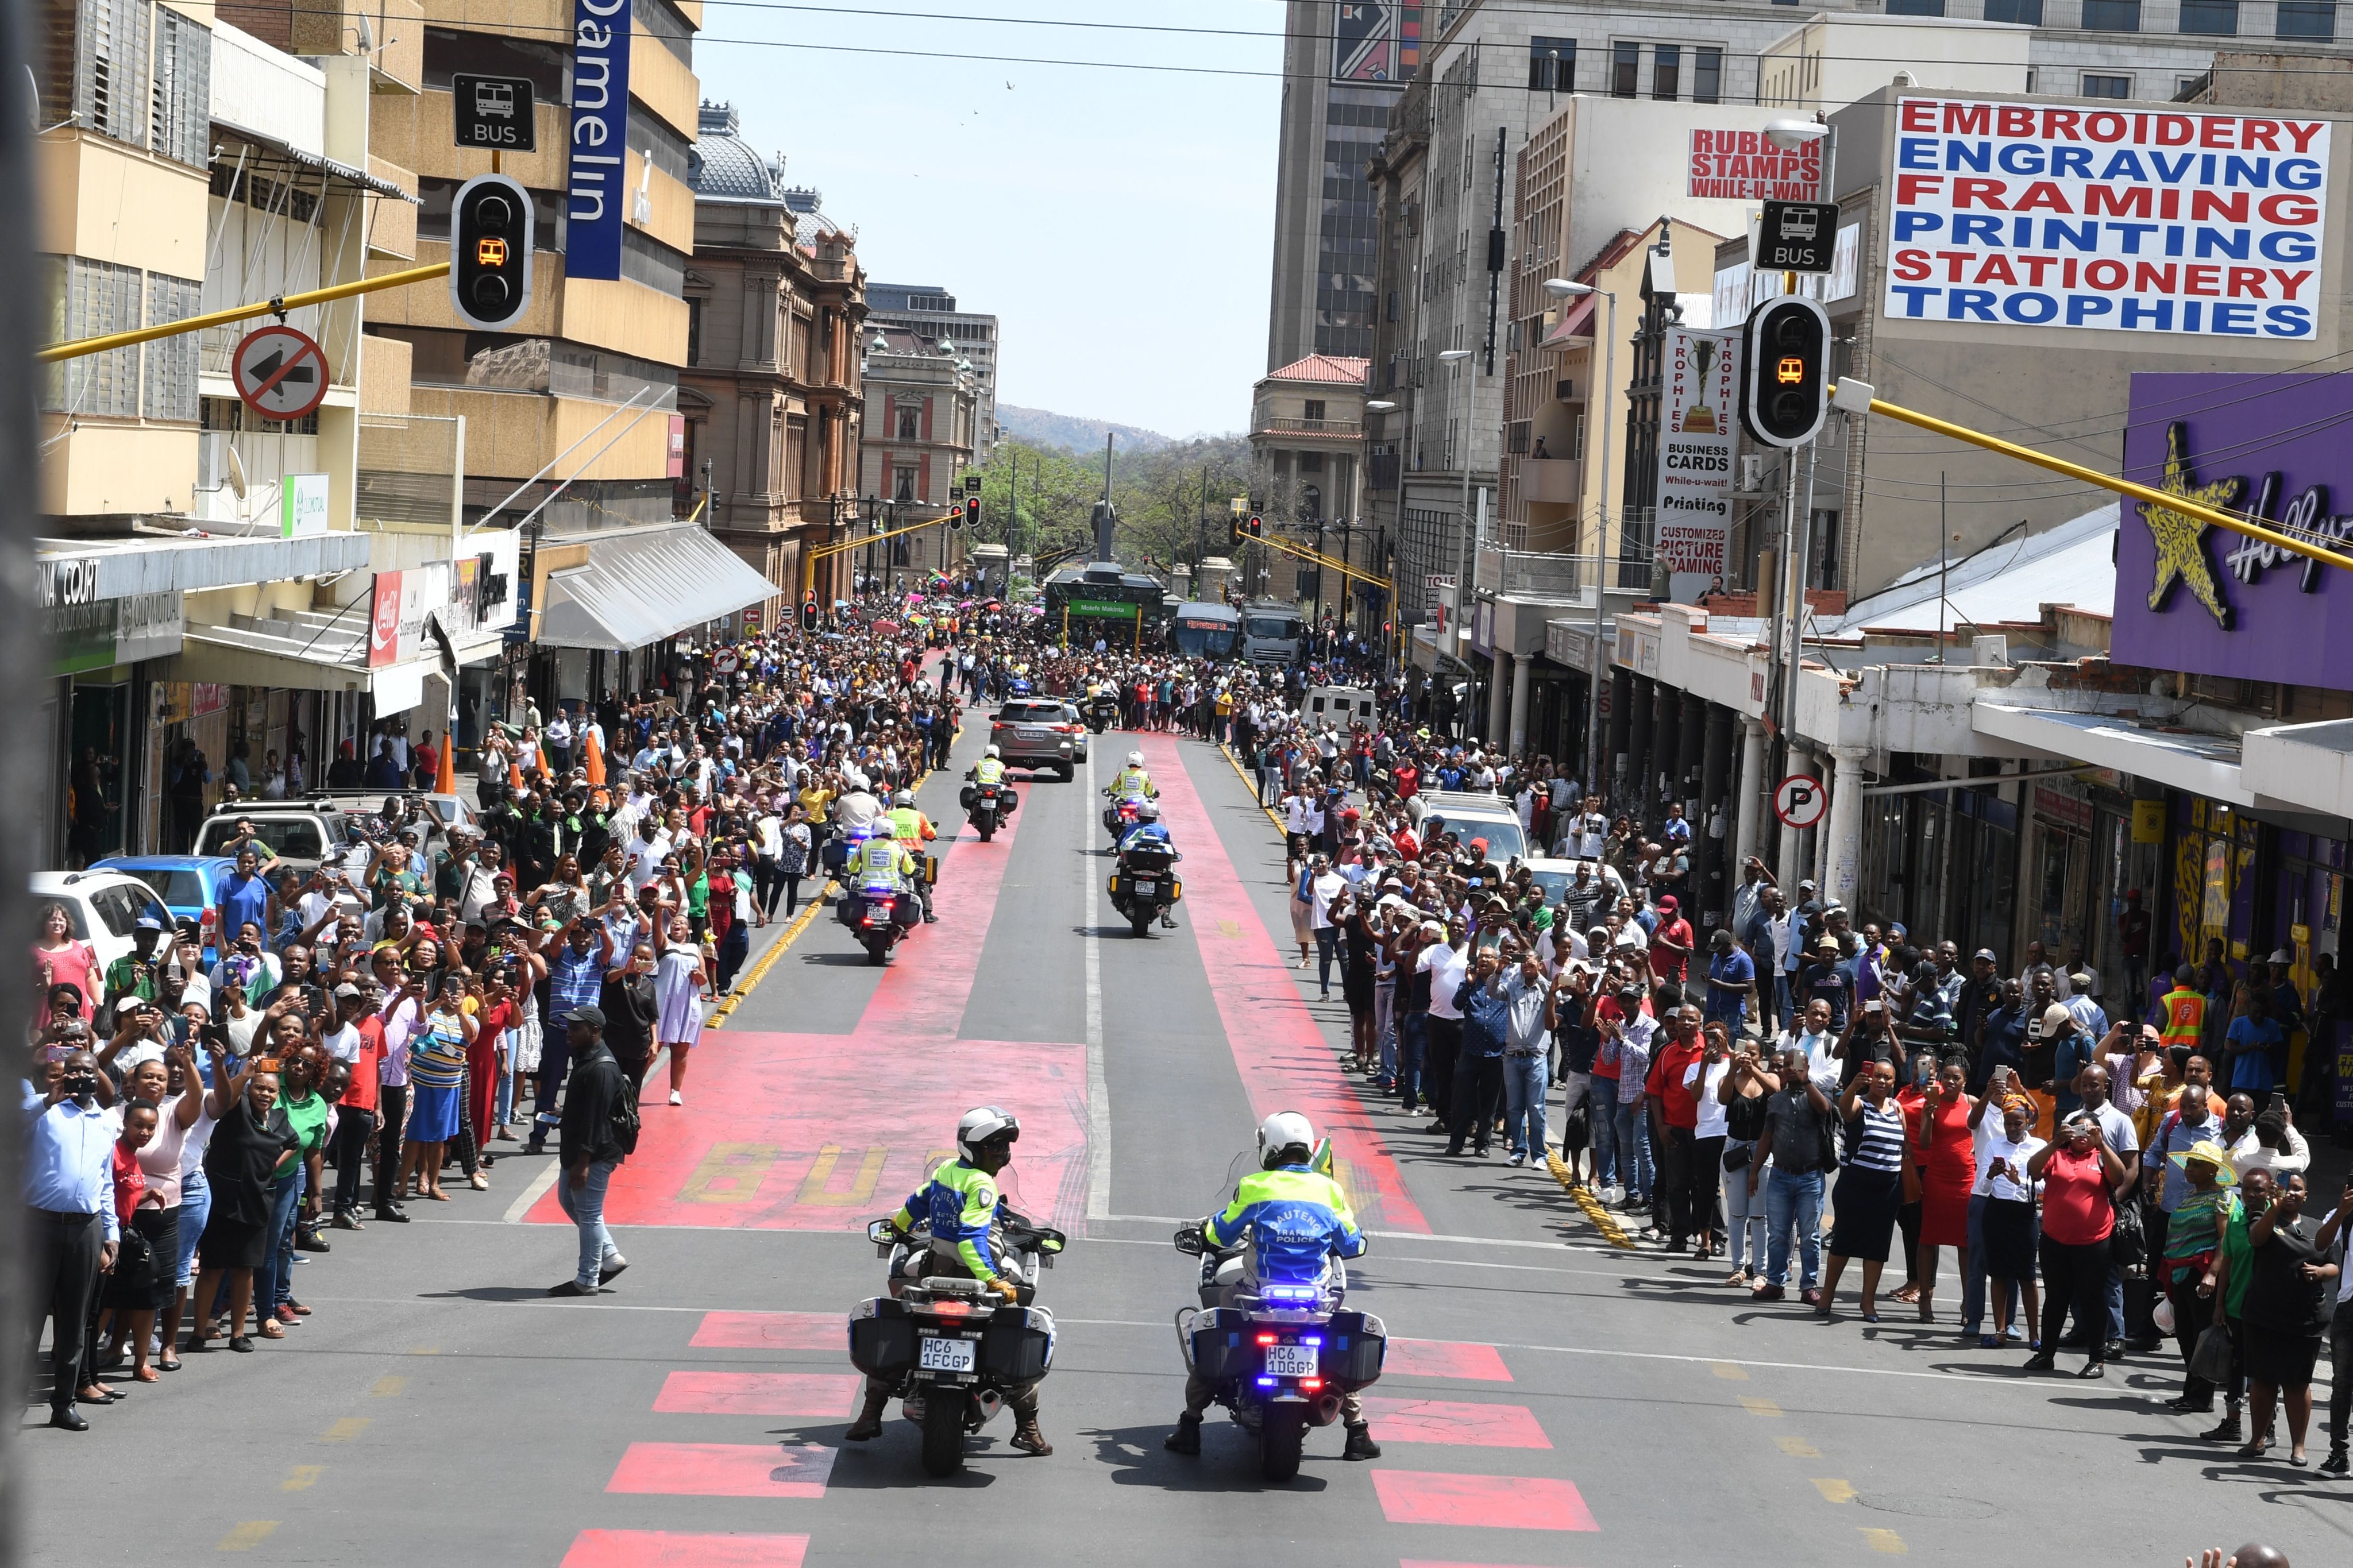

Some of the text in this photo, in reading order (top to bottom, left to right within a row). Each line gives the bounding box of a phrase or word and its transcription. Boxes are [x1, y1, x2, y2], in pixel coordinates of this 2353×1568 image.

[474, 124, 516, 144] BUS
[1902, 100, 2324, 154] EMBROIDERY
[1694, 129, 1820, 158] RUBBR
[1692, 153, 1820, 181] STAMPS
[1899, 137, 2322, 191] ENGRAVING
[1691, 178, 1819, 202] WHILE-U-WAIT
[1897, 173, 2319, 226] FRAMING
[1894, 210, 2316, 263] PRINTING
[1774, 247, 1815, 265] BUS
[1893, 249, 2313, 300] STATIONERY
[1891, 285, 2312, 337] TROPHIES
[1671, 335, 1687, 433] TROPHIES
[1718, 338, 1733, 435] TROPHIES
[1668, 443, 1729, 455] BUSINESS
[1667, 455, 1729, 472] CARDS
[1665, 476, 1727, 487] While-u-wait!
[1664, 495, 1726, 516] Printing
[1661, 526, 1725, 540] CUSTOMIZED
[1661, 540, 1724, 558] PICTURE
[1665, 557, 1723, 575] RAMING
[63, 559, 101, 605] COURT
[1426, 577, 1442, 588] TO
[134, 592, 179, 627] OLD MUTUAL
[410, 590, 417, 608] LM
[1789, 787, 1811, 814] P
[1270, 1209, 1321, 1231] GAUTENG
[924, 1339, 951, 1353] HC6
[1268, 1346, 1295, 1360] HC6
[923, 1353, 970, 1368] 1FCGP
[1268, 1360, 1314, 1374] 1DGGP
